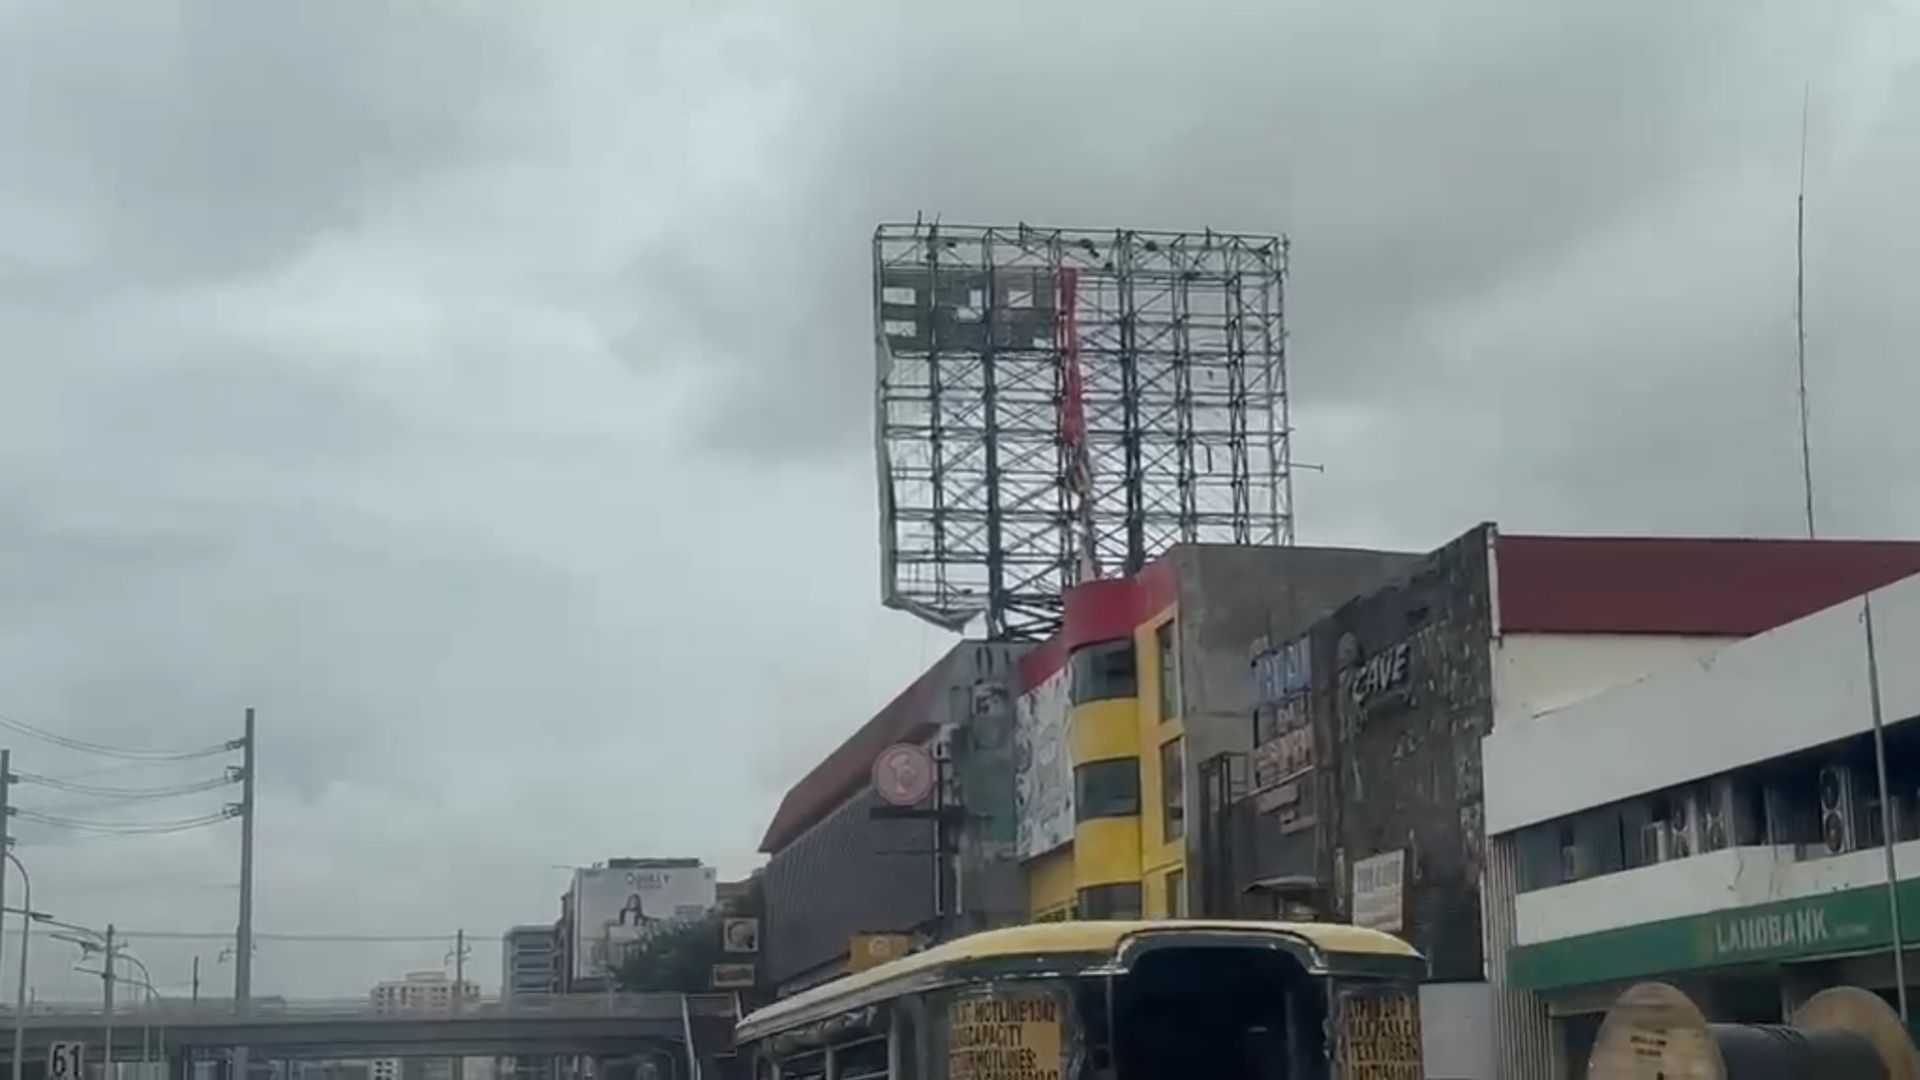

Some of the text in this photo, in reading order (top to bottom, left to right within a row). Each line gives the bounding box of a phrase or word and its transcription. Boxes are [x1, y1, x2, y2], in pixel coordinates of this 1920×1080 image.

[1351, 642, 1408, 702] CAVE
[1716, 907, 1830, 953] LANDBANK
[52, 1044, 80, 1078] 61
